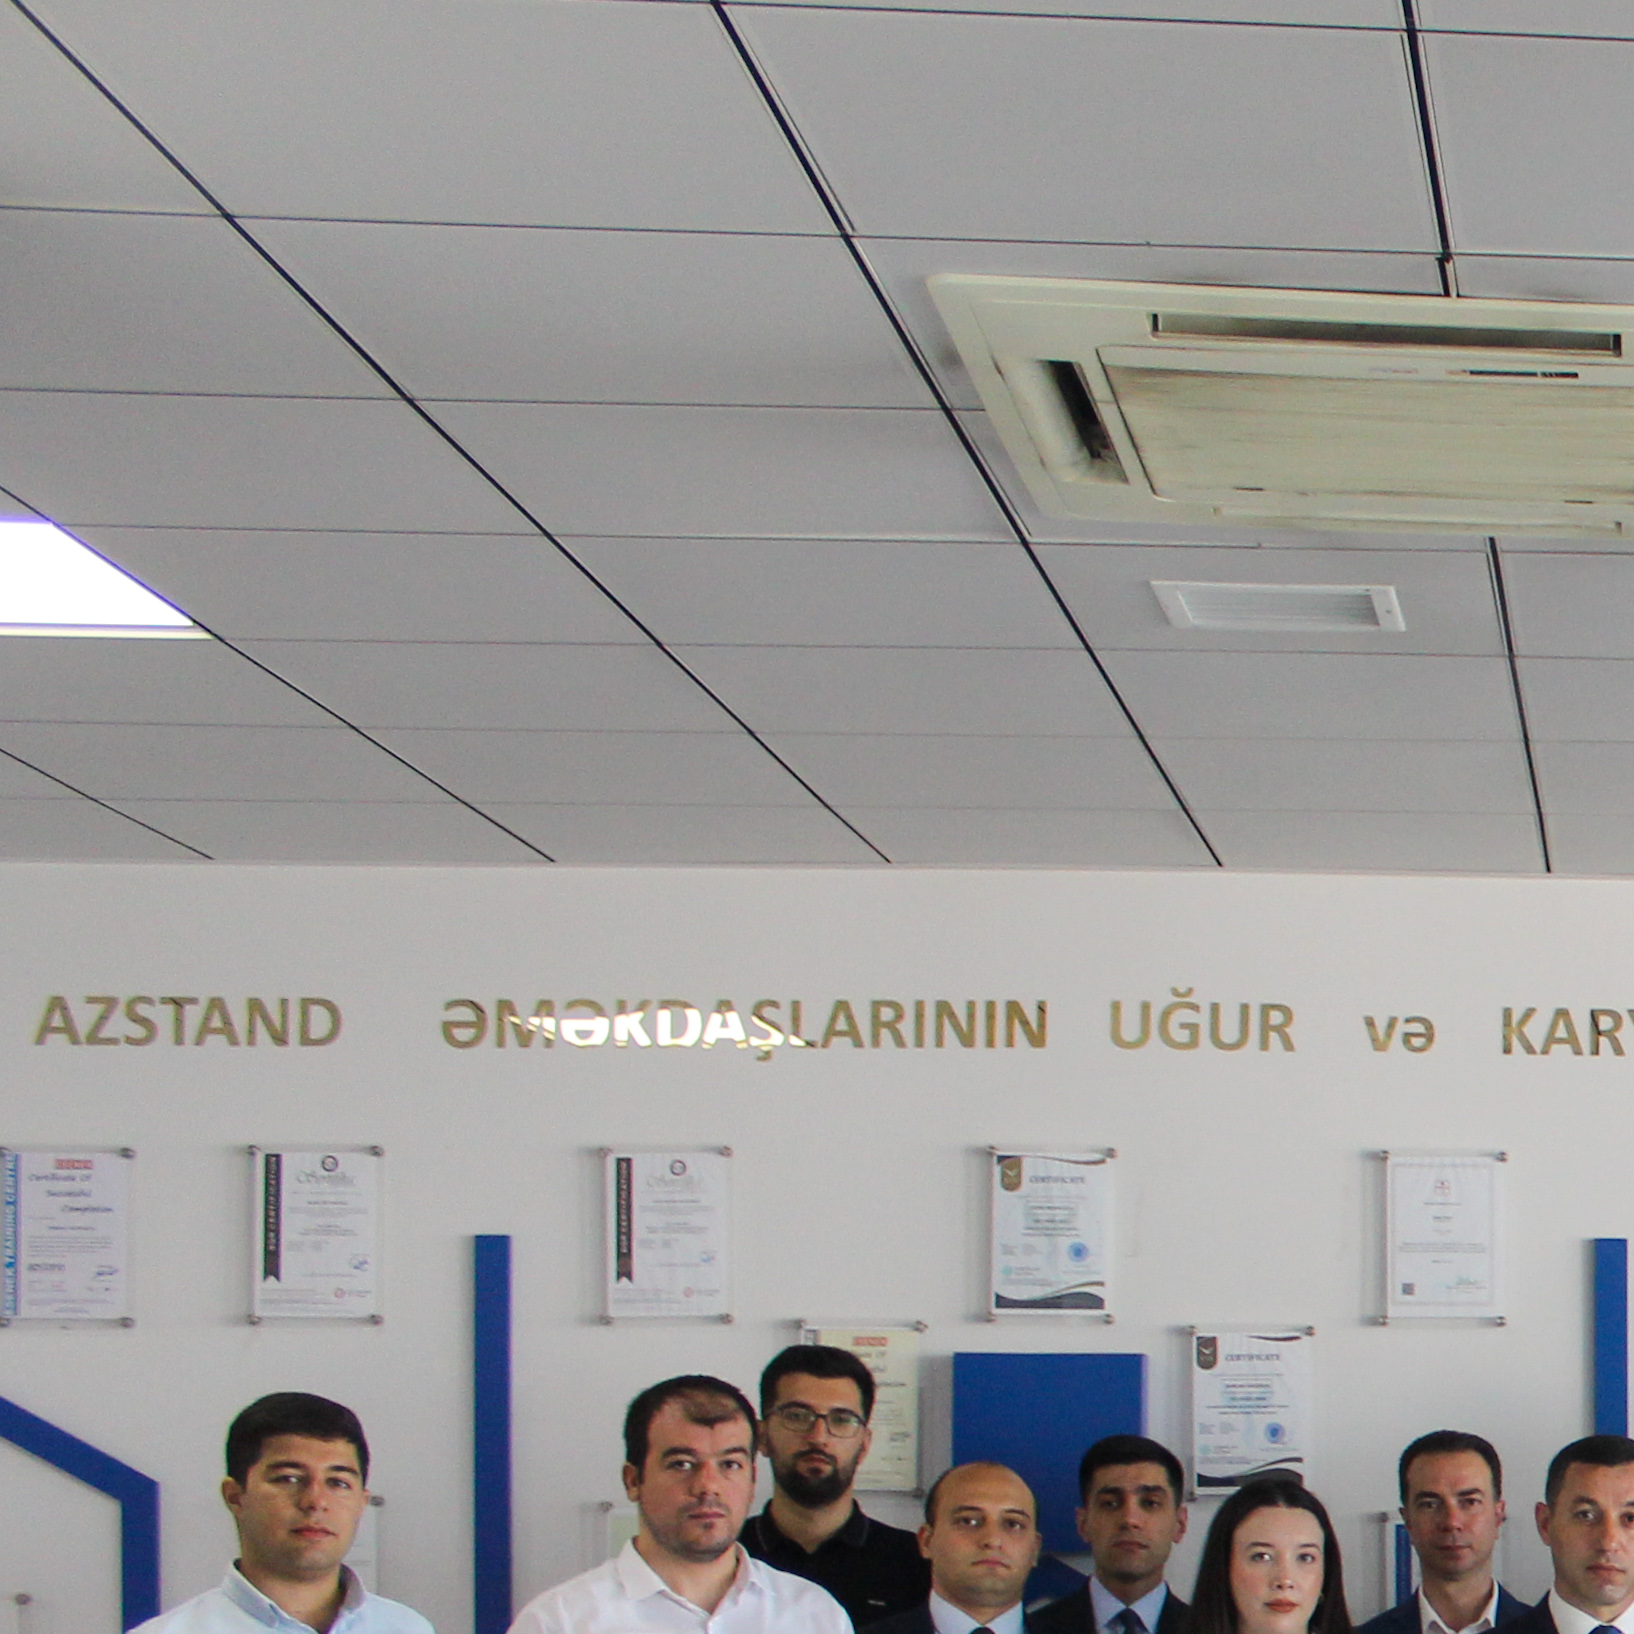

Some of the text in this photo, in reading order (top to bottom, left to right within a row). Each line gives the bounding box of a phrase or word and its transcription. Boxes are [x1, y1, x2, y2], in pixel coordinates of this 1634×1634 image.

[34, 996, 342, 1047] AZSTAND
[442, 998, 1049, 1061] ƏMƏKDAŞLARININ
[1109, 987, 1296, 1052] UĞUR
[1363, 1013, 1435, 1054] və
